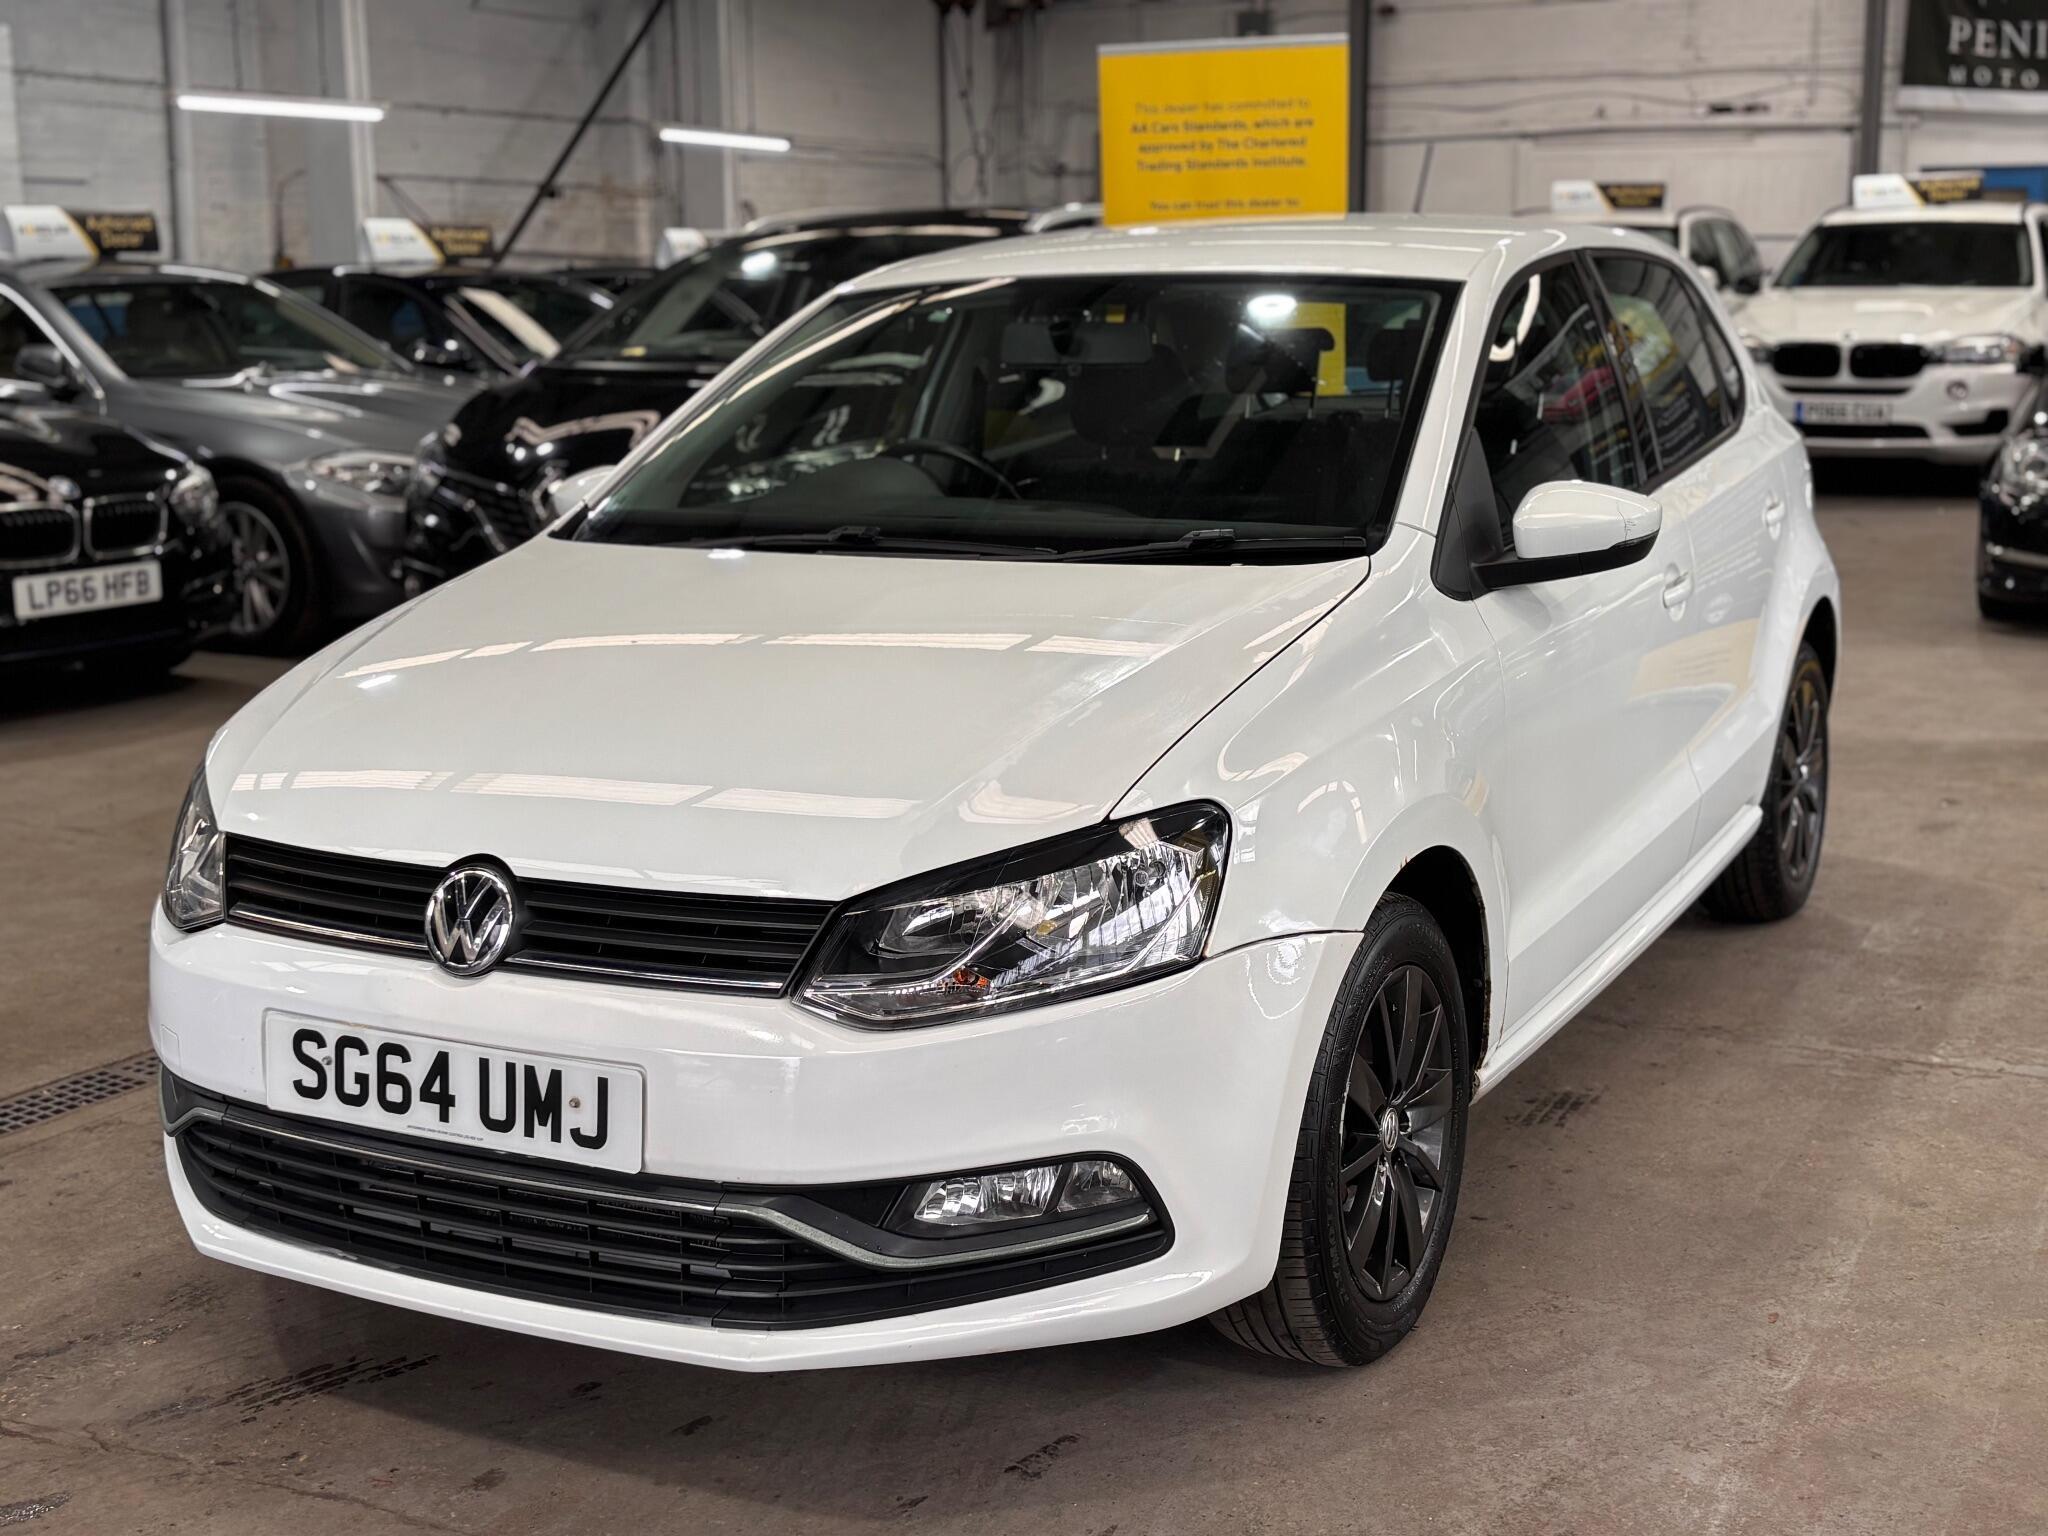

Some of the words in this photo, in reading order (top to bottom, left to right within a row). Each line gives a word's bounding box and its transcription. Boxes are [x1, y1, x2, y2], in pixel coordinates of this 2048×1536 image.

[1948, 15, 2048, 59] PENI
[27, 576, 98, 611] LP66
[103, 569, 150, 600] HFB
[292, 1028, 456, 1124] SG64
[478, 1056, 609, 1150] UMJ
